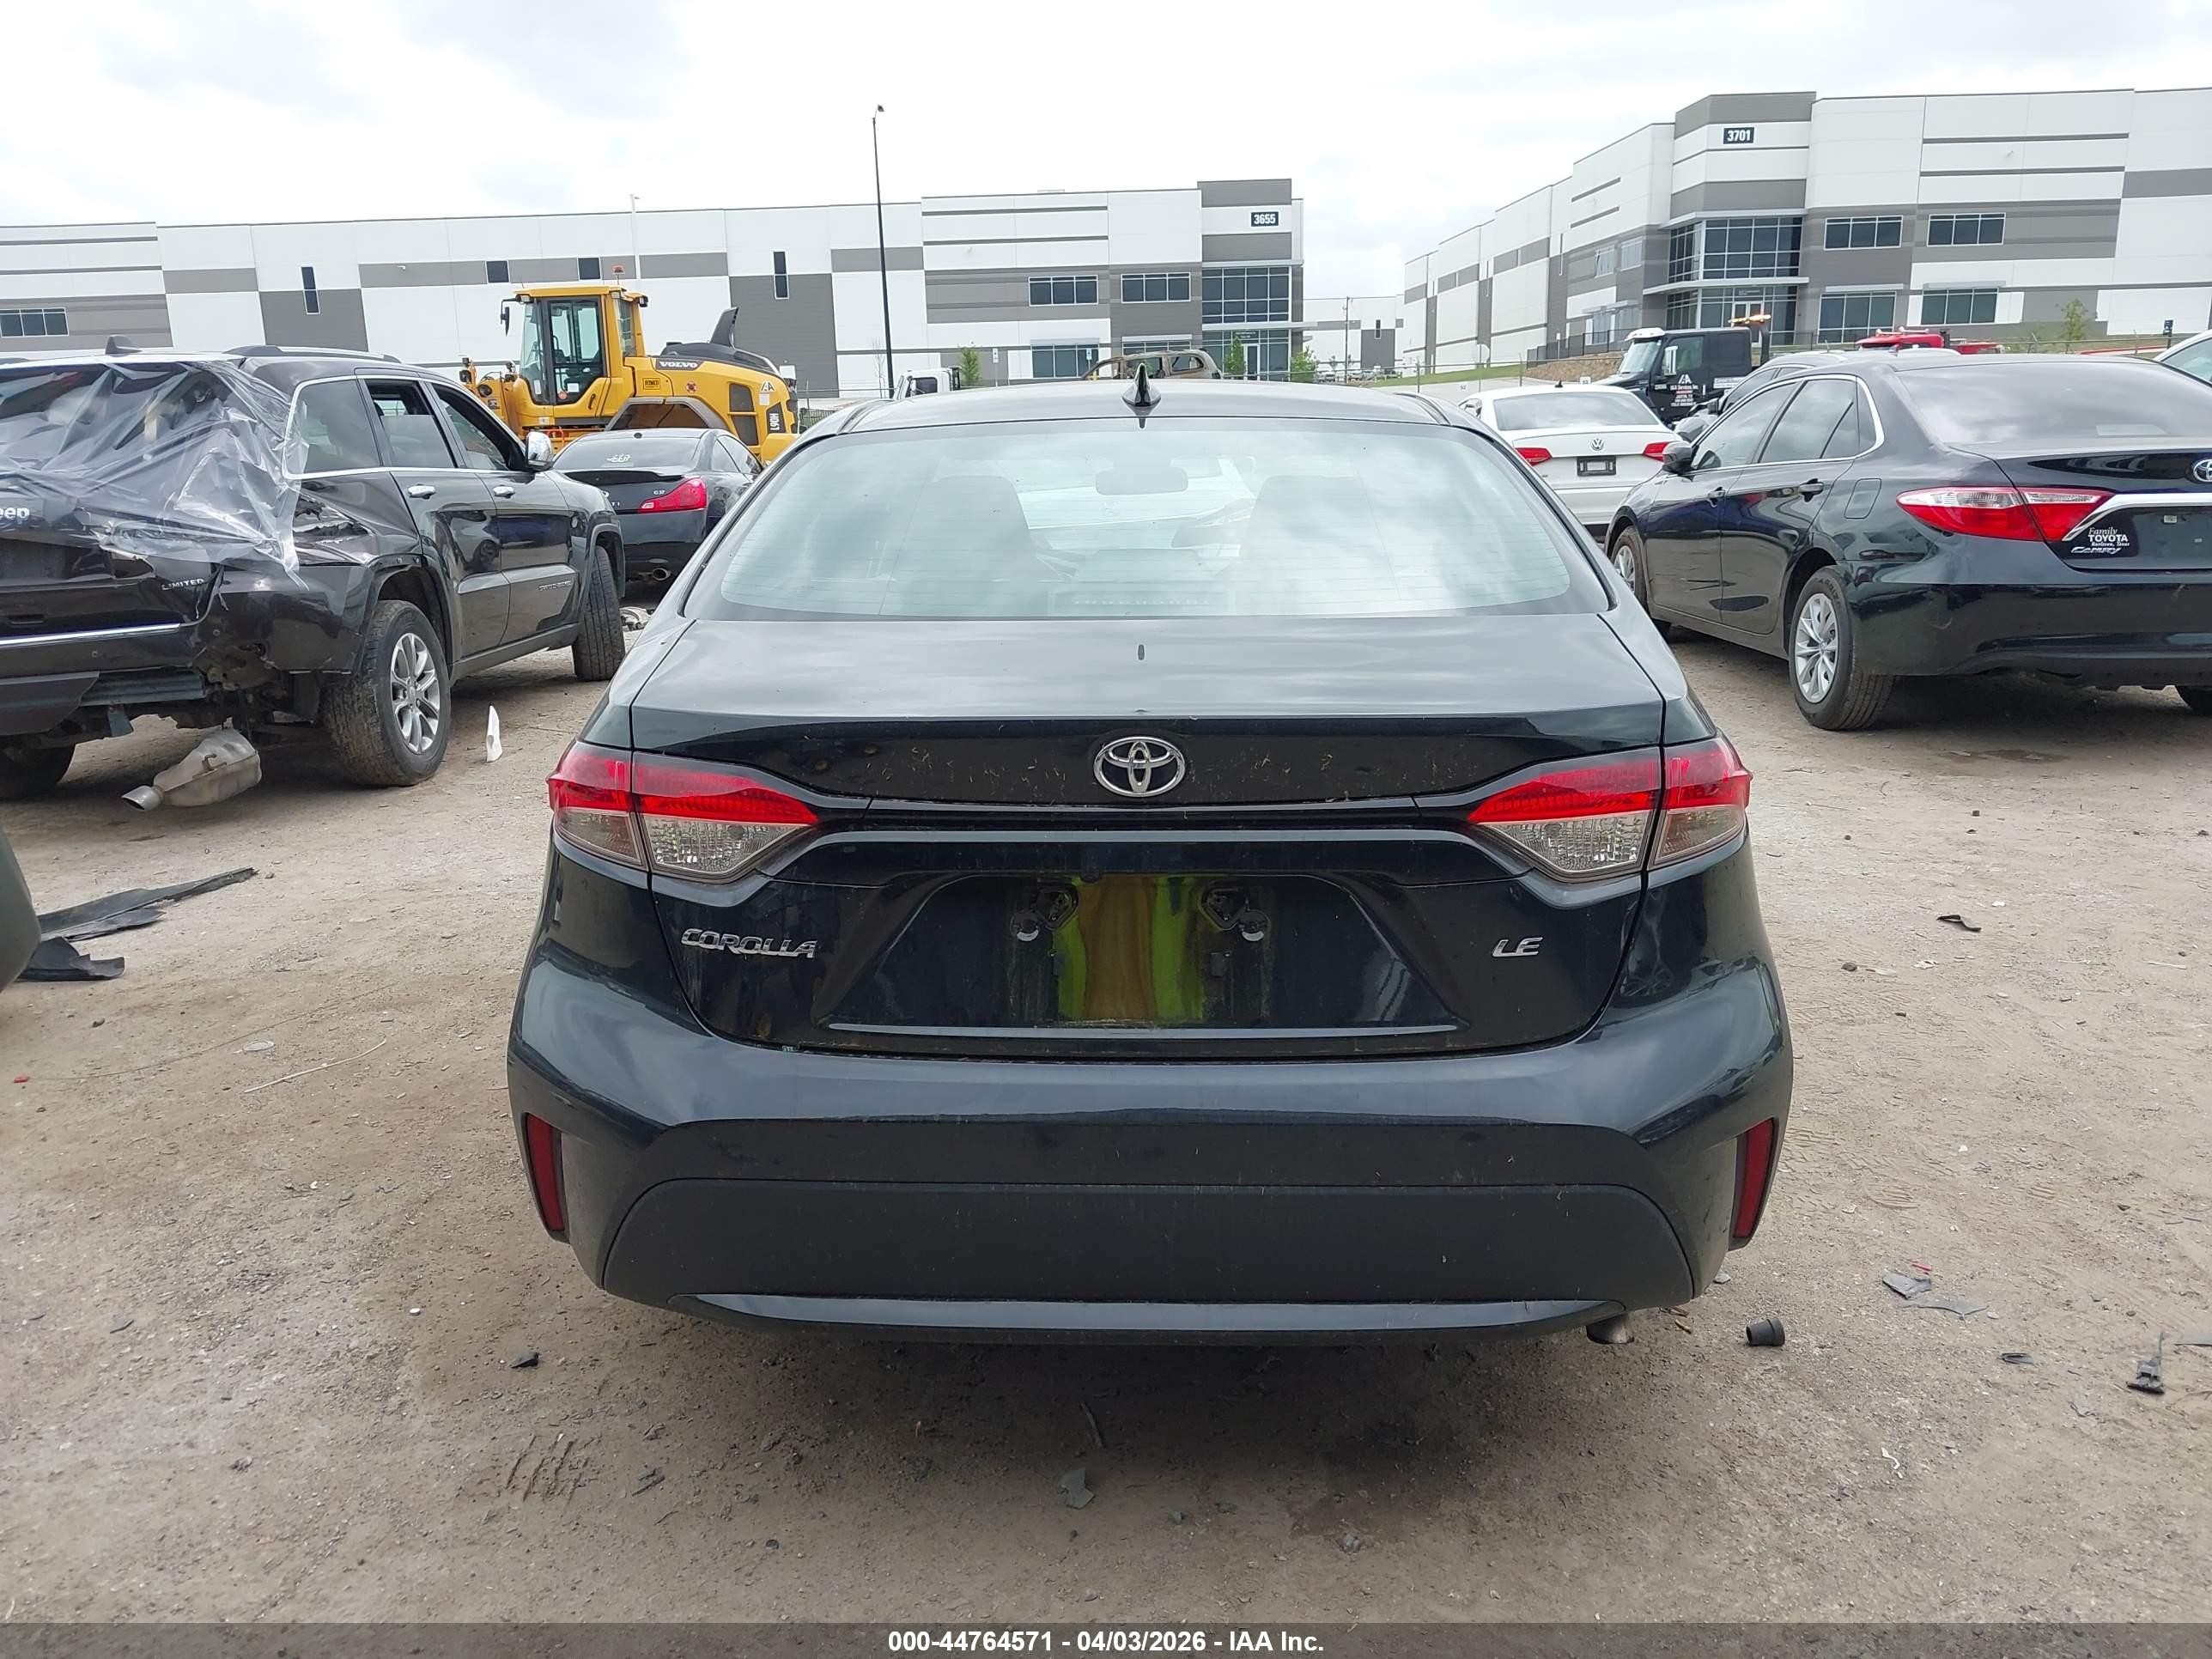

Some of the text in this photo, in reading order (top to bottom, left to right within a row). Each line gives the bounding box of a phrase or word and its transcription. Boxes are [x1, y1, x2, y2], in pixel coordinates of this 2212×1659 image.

[1727, 129, 1751, 142] 3701
[1254, 213, 1276, 225] 3655
[769, 413, 781, 430] L90H
[2088, 526, 2118, 535] Family
[2070, 546, 2122, 555] CAMRY
[161, 578, 205, 591] LIMITED
[680, 927, 817, 958] COROLLA
[1492, 937, 1544, 957] LE
